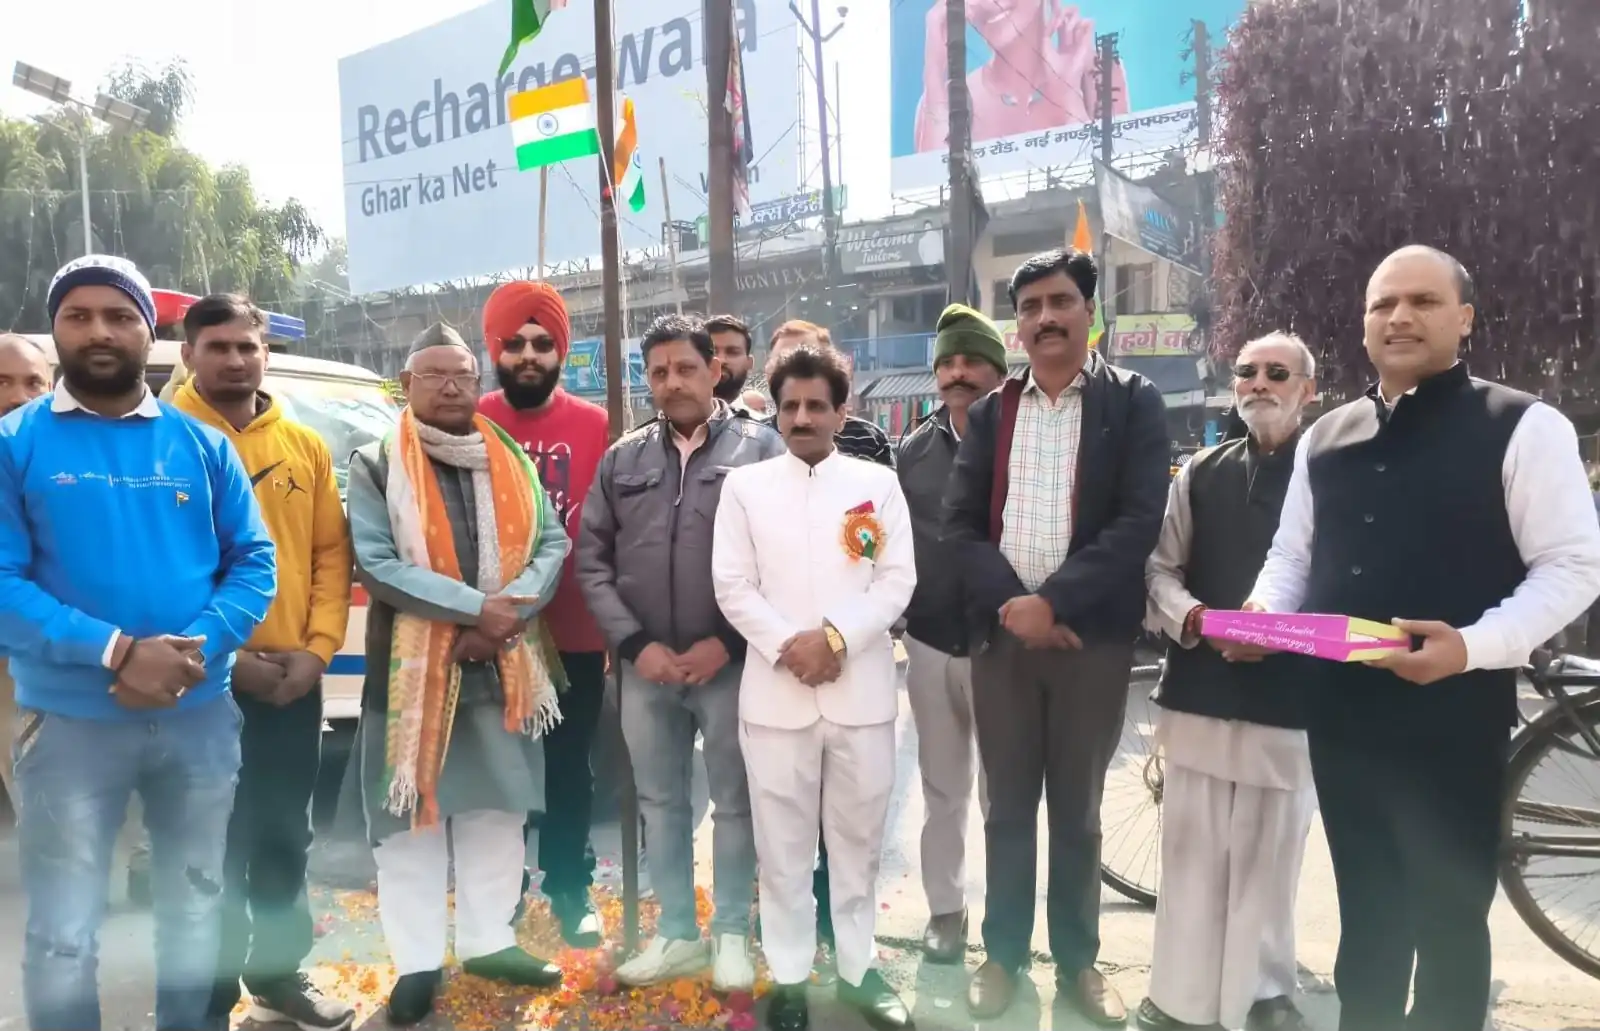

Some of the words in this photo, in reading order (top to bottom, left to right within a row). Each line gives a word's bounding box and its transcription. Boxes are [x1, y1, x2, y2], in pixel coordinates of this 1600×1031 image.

[1024, 130, 1052, 149] नई
[361, 182, 412, 217] Ghar
[418, 173, 446, 205] ka
[452, 158, 499, 198] Net
[846, 229, 916, 252] Welcome
[1224, 627, 1268, 646] Unlimited
[1268, 634, 1316, 655] Celebration
